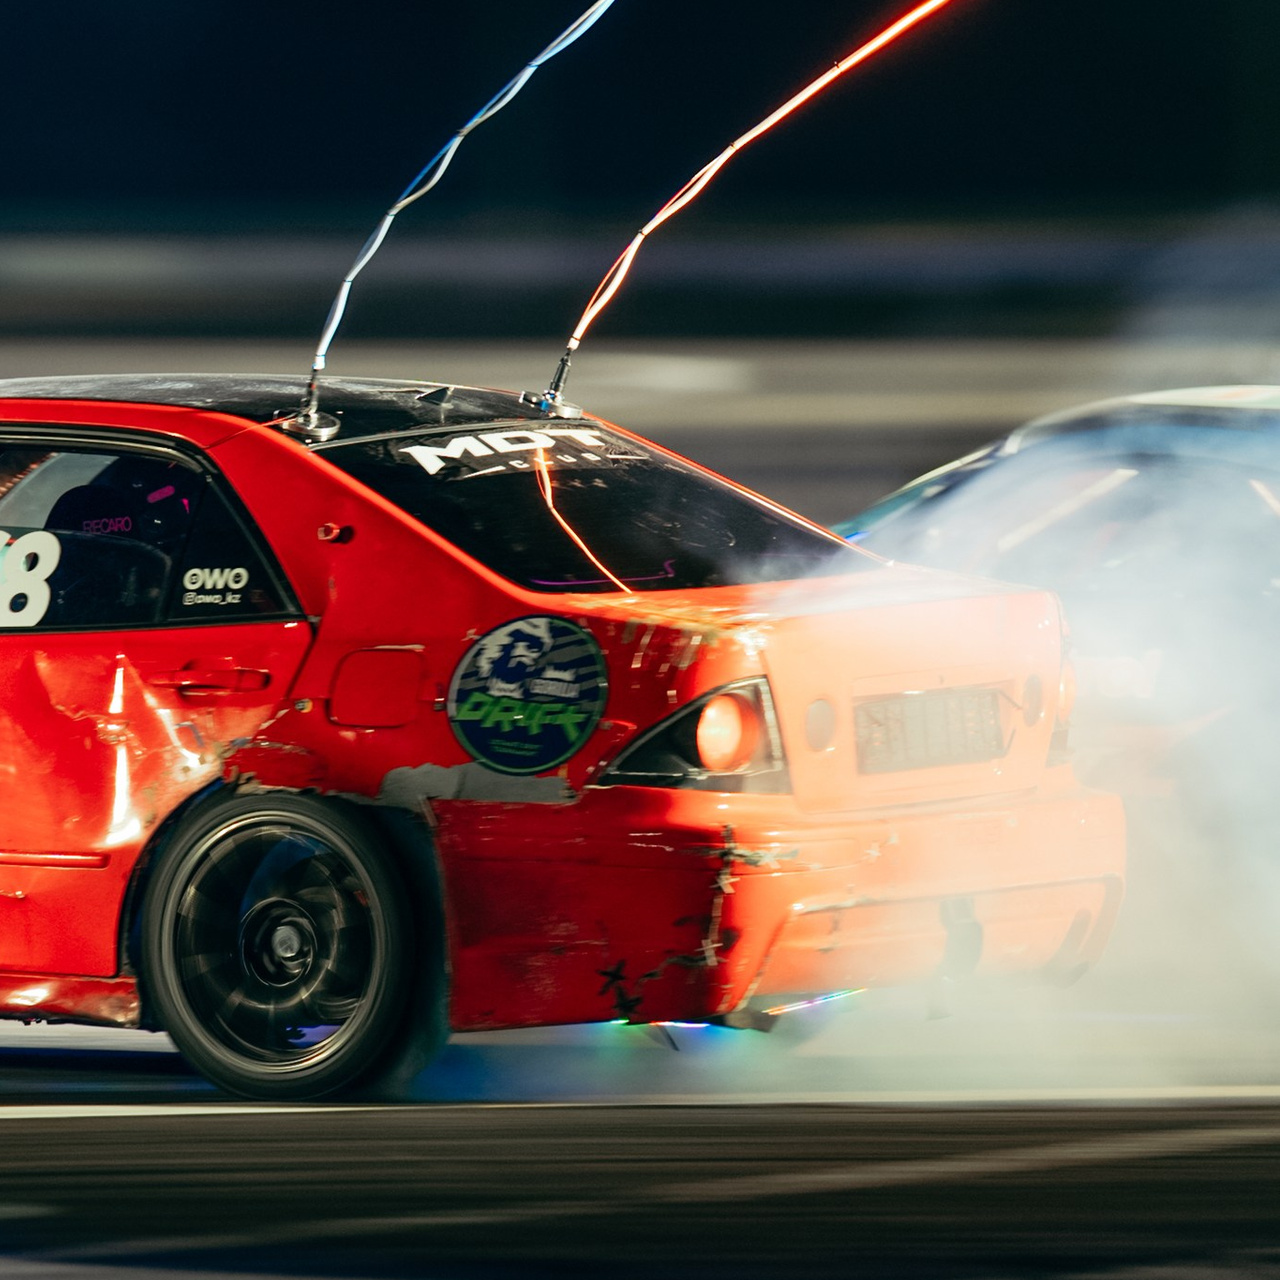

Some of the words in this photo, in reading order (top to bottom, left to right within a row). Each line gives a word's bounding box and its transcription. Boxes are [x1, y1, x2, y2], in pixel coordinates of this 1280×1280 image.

[398, 428, 606, 476] MDT
[83, 516, 132, 534] RECARO
[183, 567, 249, 590] OWO
